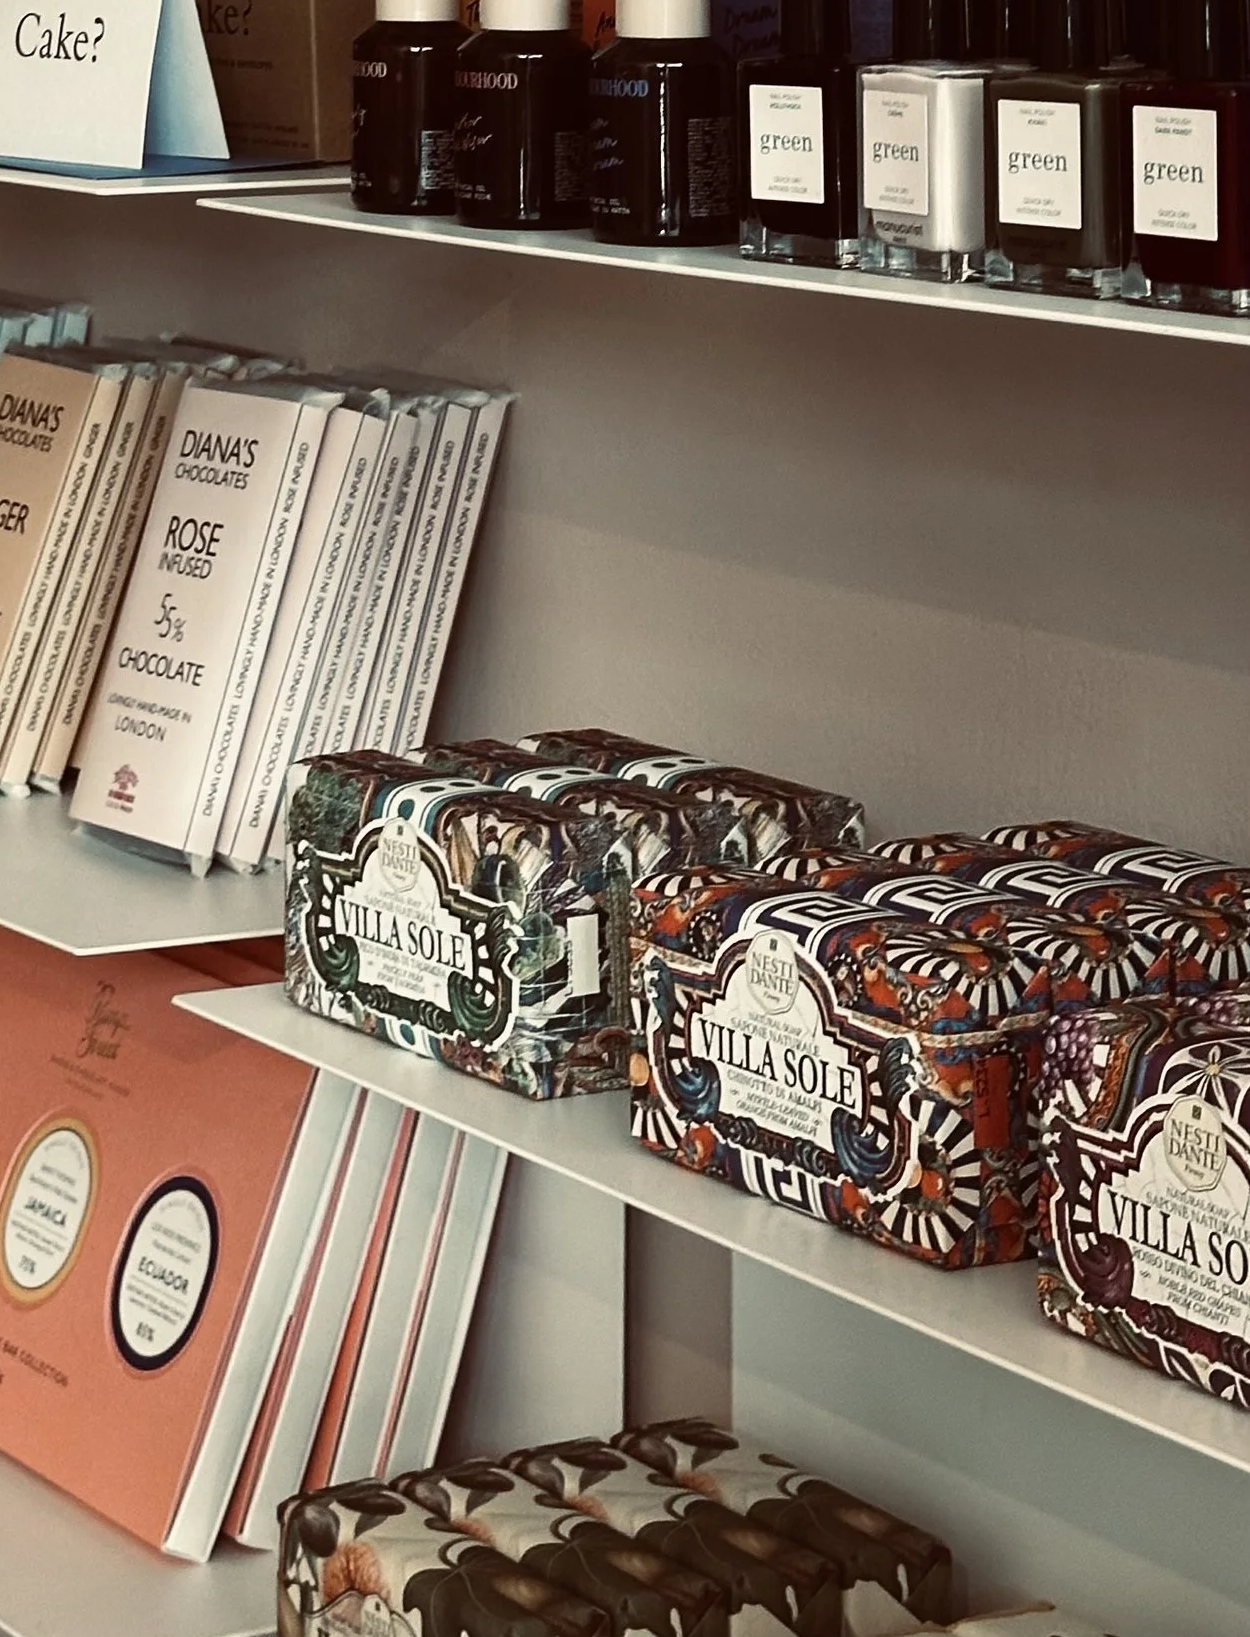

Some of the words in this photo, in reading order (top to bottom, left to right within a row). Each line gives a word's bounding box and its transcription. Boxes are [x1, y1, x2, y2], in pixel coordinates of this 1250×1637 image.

[14, 12, 105, 64] Cake?
[760, 133, 813, 154] green
[872, 141, 919, 163] green
[1008, 151, 1068, 174] green
[1143, 161, 1205, 185] green
[180, 428, 260, 468] DIANA'S
[174, 461, 251, 491] CHOCOLATES
[163, 515, 225, 558] ROSE
[271, 518, 291, 566] LONDON
[158, 552, 213, 580] INFUSED
[153, 592, 186, 643] 55%
[119, 647, 205, 687] CHOCOLATE
[114, 715, 167, 742] LONDON
[340, 898, 403, 951] VILLA
[408, 921, 465, 971] SOLE
[752, 951, 794, 977] NESTI
[750, 968, 794, 996] DANTE
[699, 1018, 778, 1082] VILLA
[784, 1048, 856, 1109] SOLE
[1171, 1118, 1220, 1153] NESTI
[1169, 1138, 1220, 1171] DANTE
[1107, 1189, 1200, 1267] VILLA
[1209, 1231, 1248, 1285] SO
[138, 1256, 190, 1295] ECUADOR
